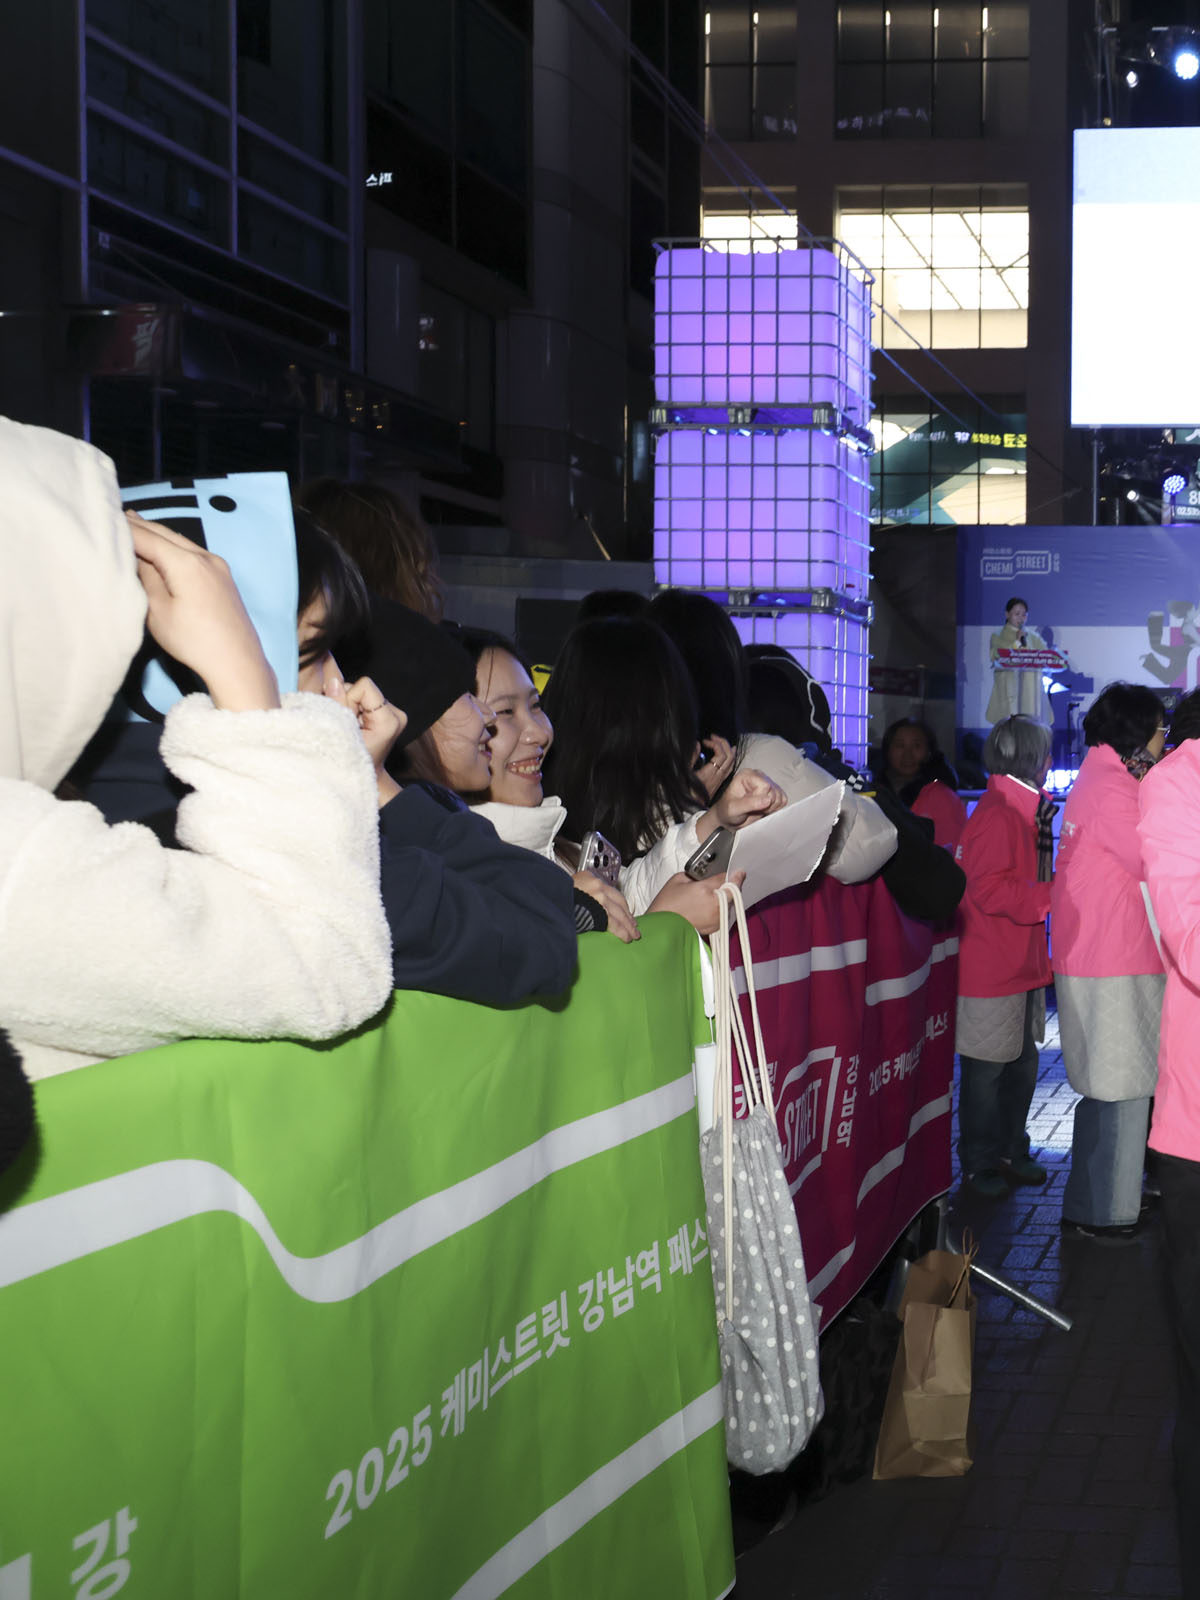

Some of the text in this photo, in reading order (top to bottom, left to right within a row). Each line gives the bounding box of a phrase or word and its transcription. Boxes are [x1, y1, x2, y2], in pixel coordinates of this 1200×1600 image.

[985, 562, 1013, 575] CHEMI
[1016, 556, 1046, 569] STREET
[324, 1404, 432, 1540] 2025
[440, 1290, 570, 1437] 케미스트릿
[578, 1240, 662, 1333] 강남역
